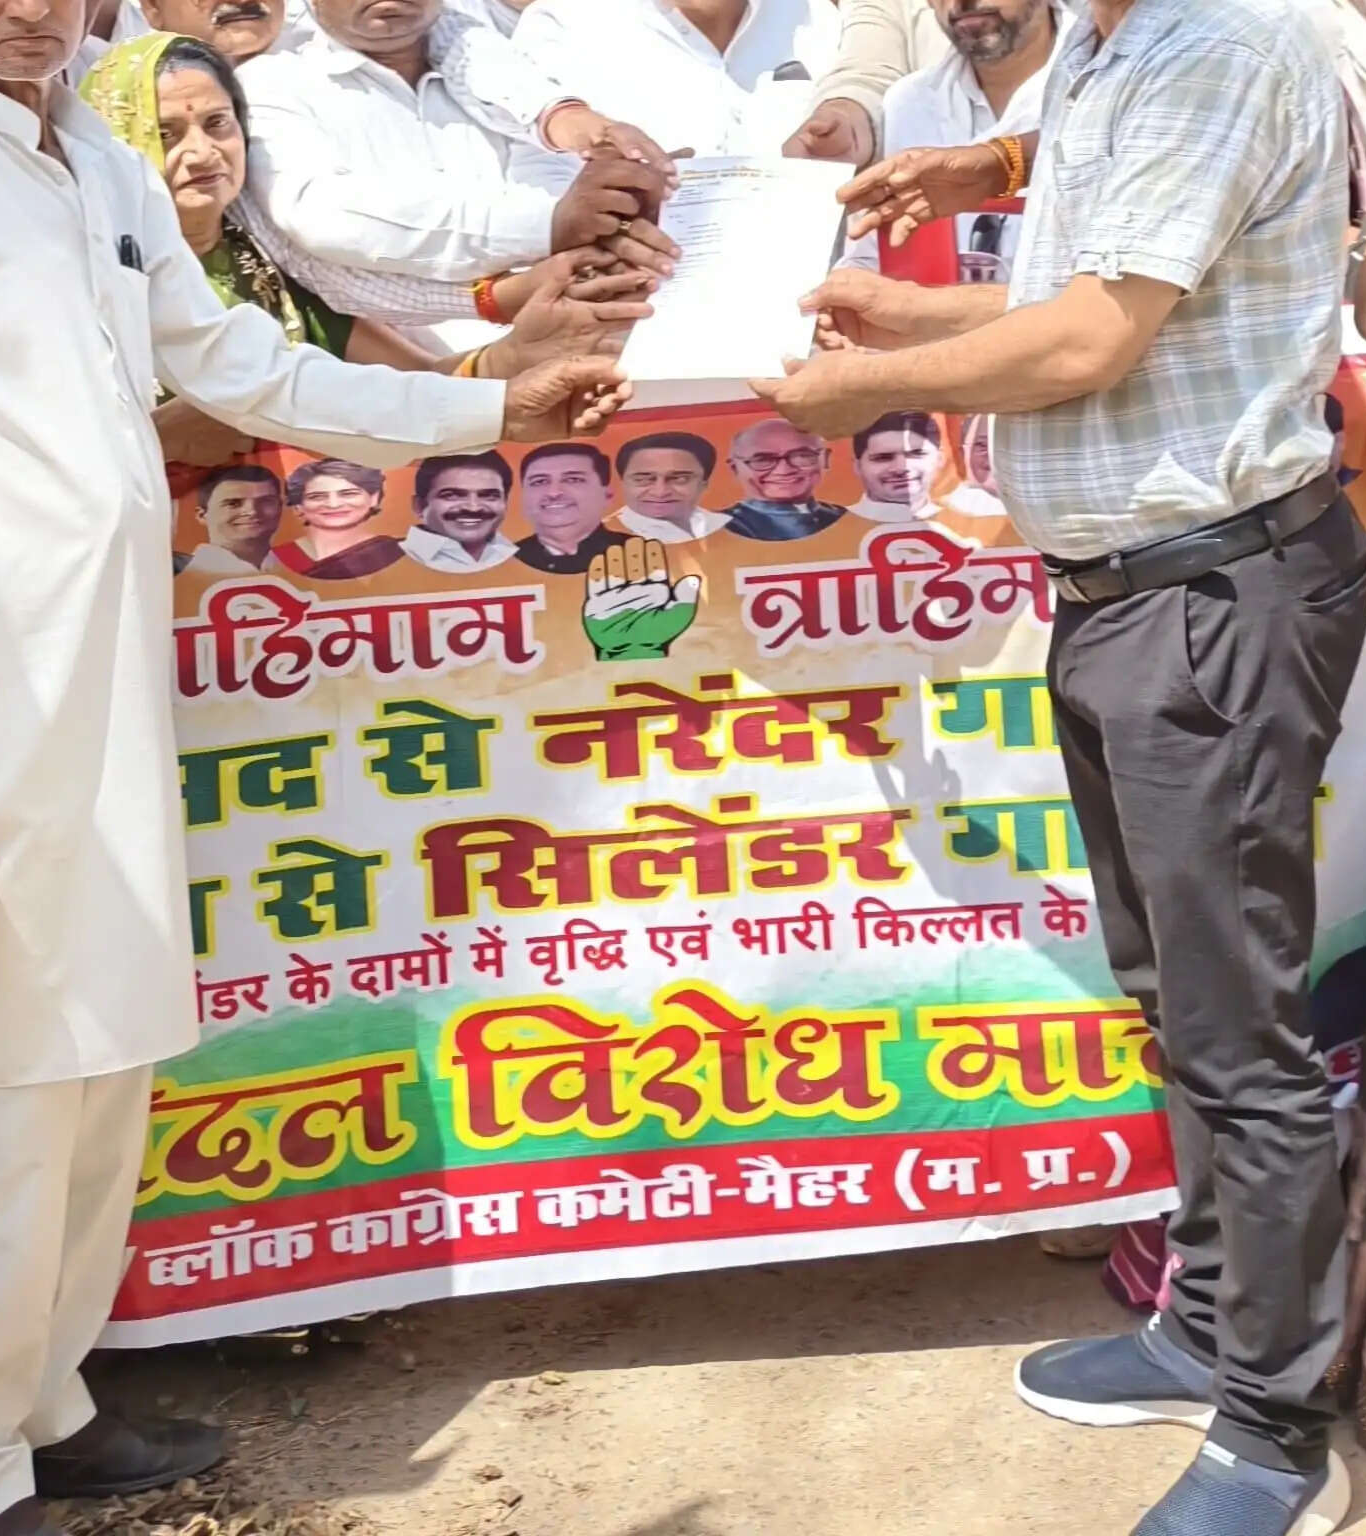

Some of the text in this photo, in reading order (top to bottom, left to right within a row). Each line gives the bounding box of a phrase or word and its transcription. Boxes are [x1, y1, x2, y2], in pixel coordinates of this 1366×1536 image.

[363, 700, 494, 795] से
[534, 674, 901, 780] नरेंदर
[257, 839, 382, 937] से
[421, 796, 911, 919] सिलेंडर
[286, 953, 332, 1004] के
[347, 931, 451, 996] दामों
[470, 926, 506, 977] में
[526, 918, 628, 985] वृद्धि
[647, 910, 711, 966] एवं
[733, 901, 835, 955] भारी
[854, 897, 1022, 948] किल्लत
[1040, 885, 1088, 938] के
[452, 988, 887, 1137] विरोध
